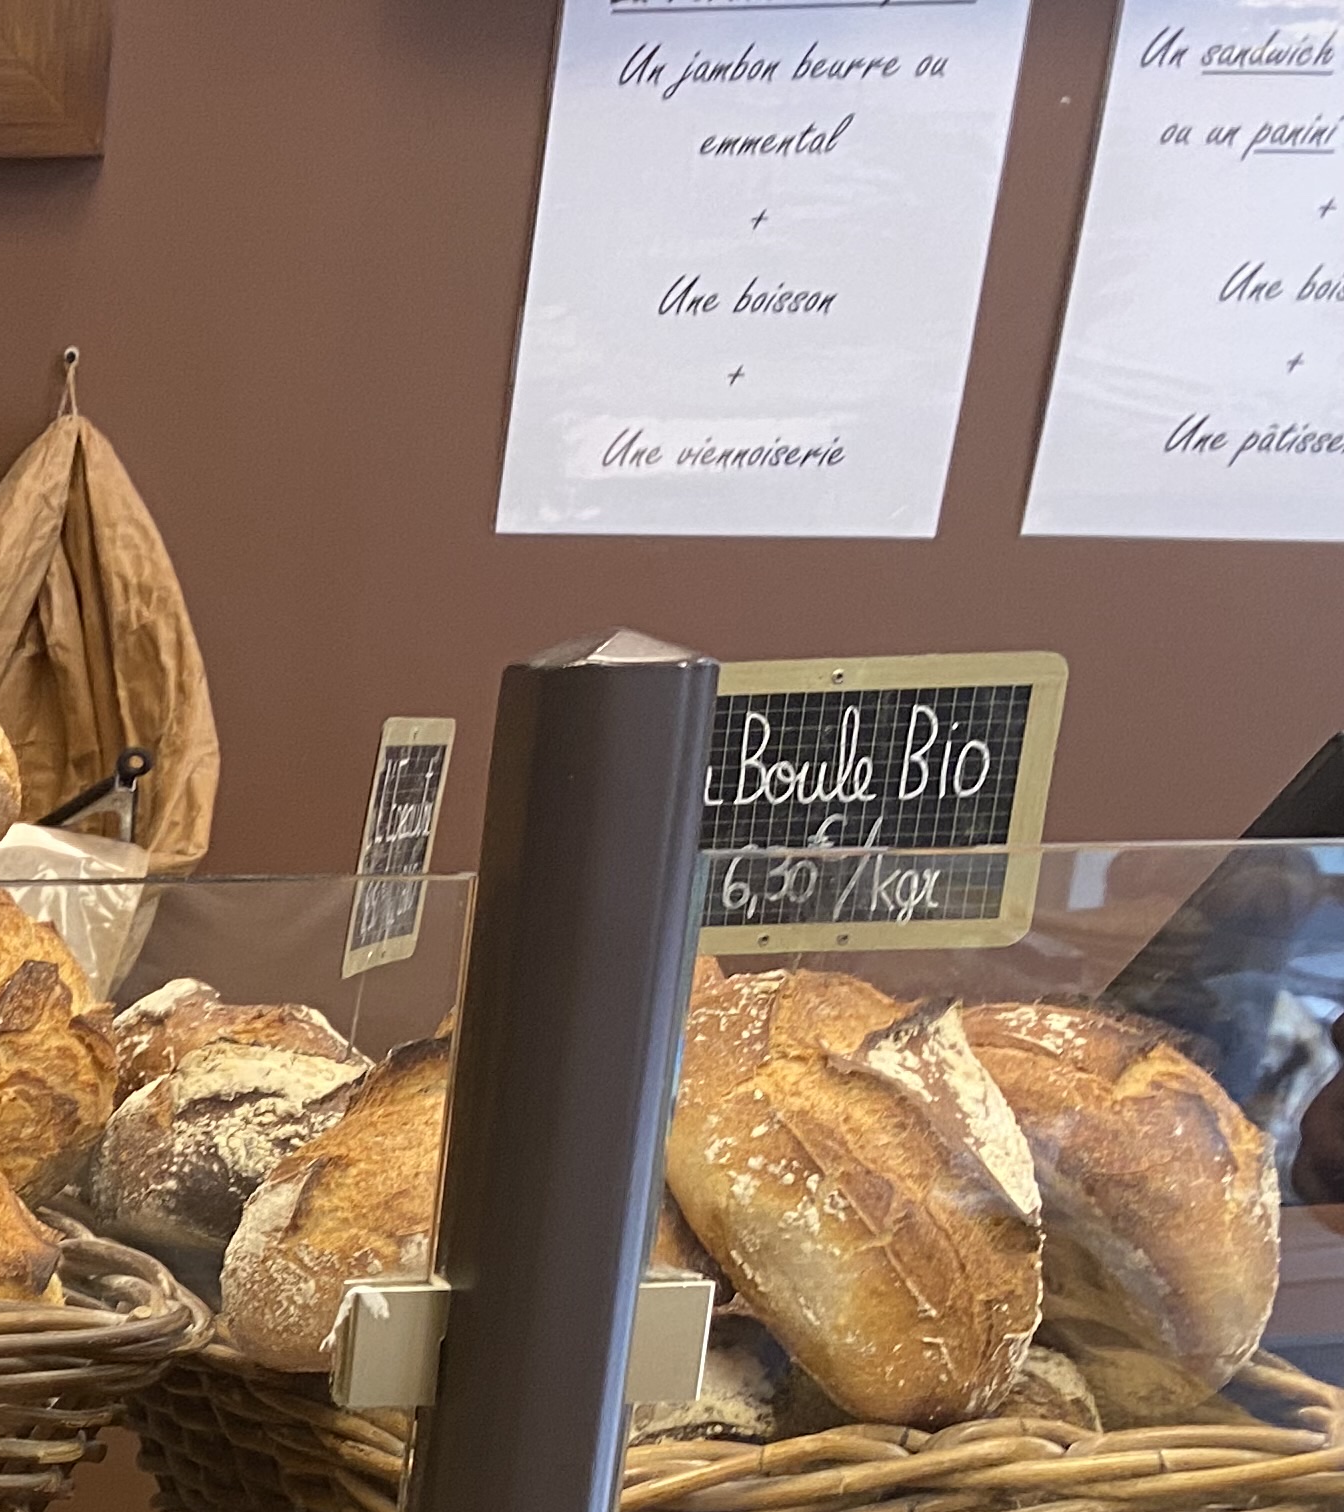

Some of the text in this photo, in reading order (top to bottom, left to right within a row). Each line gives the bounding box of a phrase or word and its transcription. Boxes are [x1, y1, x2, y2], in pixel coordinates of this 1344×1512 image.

[1140, 26, 1340, 68] Un sandwich
[617, 43, 950, 101] Un jambon beurre ou
[700, 112, 856, 157] emmental
[1160, 114, 1344, 162] ou un panini
[658, 276, 839, 316] Une boisson
[1218, 261, 1284, 302] Une
[602, 428, 846, 470] Une viennoiserie
[1164, 412, 1229, 455] Une
[733, 704, 877, 807] Boule
[898, 703, 992, 802] Bio
